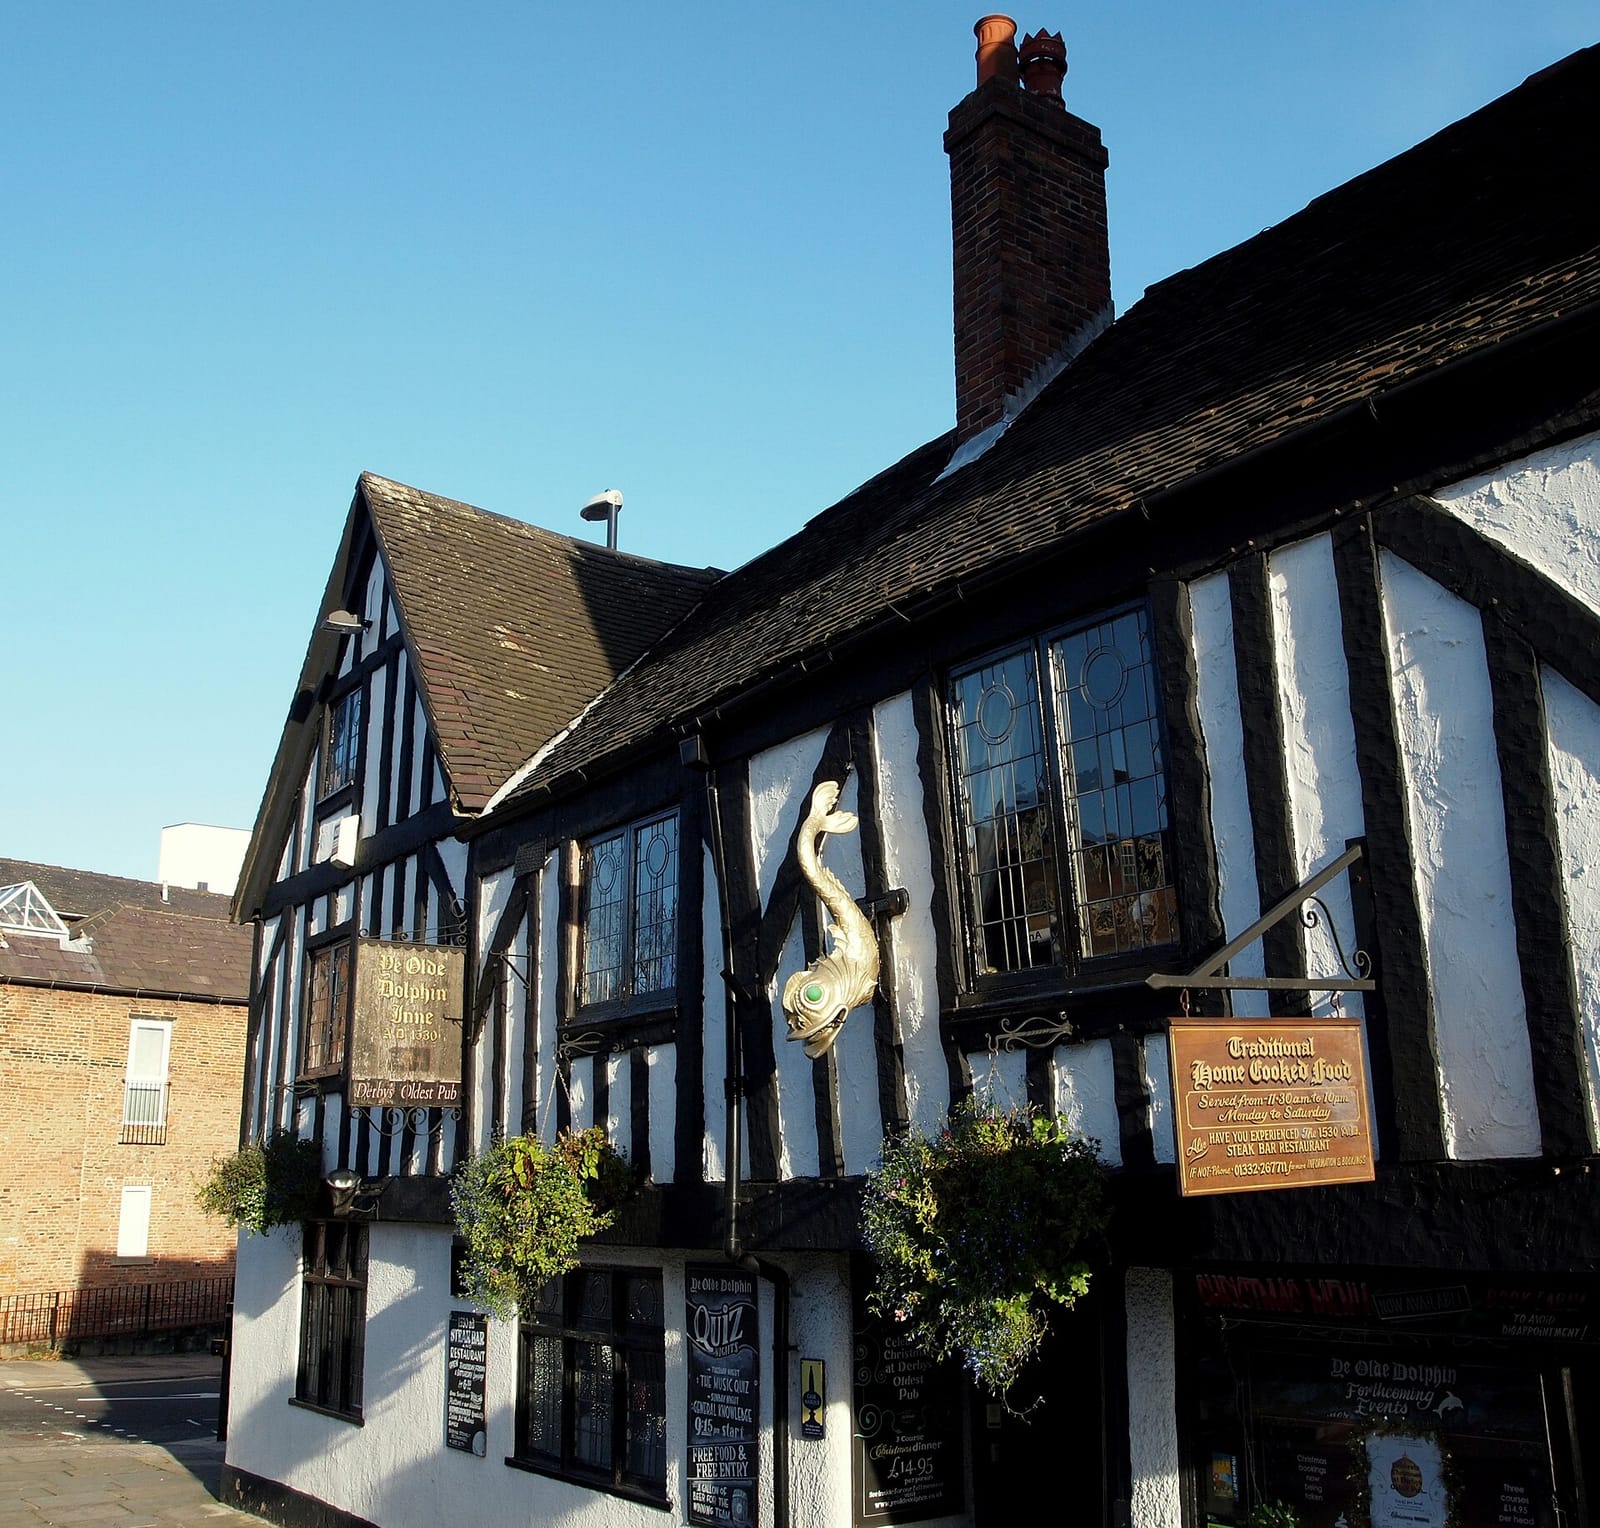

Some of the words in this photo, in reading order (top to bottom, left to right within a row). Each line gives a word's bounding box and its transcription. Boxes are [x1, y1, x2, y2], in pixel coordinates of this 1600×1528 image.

[406, 956, 446, 976] Olde
[379, 979, 448, 1004] Dolphin
[391, 1004, 434, 1024] Inne
[412, 1029, 438, 1041] 1530
[1227, 1036, 1315, 1058] Traditional
[1191, 1060, 1245, 1090] Home
[1249, 1058, 1309, 1085] Cooked
[1310, 1057, 1352, 1085] Food
[355, 1082, 394, 1099] Derby's
[401, 1082, 434, 1100] Oldest
[438, 1084, 457, 1100] Pub
[1199, 1094, 1237, 1108] Served
[1311, 1092, 1321, 1103] to
[1218, 1108, 1267, 1123] Monday
[1270, 1109, 1281, 1119] to
[1283, 1105, 1330, 1121] Saturday
[1209, 1131, 1230, 1145] HAVE
[1232, 1130, 1248, 1143] YOU
[1250, 1128, 1299, 1142] EXPERIENCED
[1301, 1127, 1316, 1139] The
[1319, 1126, 1338, 1138] 1530
[1227, 1143, 1254, 1156] STEAK
[1258, 1142, 1277, 1155] BAR
[1279, 1139, 1330, 1154] RESTAURANT
[1189, 1167, 1196, 1179] IF
[1306, 1157, 1336, 1170] INFORMATION
[702, 1278, 719, 1291] Olde
[720, 1279, 752, 1294] Dolphin
[1513, 1313, 1526, 1324] TO
[450, 1328, 471, 1343] STEAK
[471, 1330, 485, 1346] BAR
[450, 1346, 485, 1363] RESTAURANT
[885, 1363, 895, 1374] at
[1354, 1359, 1391, 1377] Olde
[1391, 1361, 1457, 1388] Dolphin
[699, 1374, 712, 1388] THE
[713, 1376, 733, 1392] MUSIC
[734, 1379, 749, 1394] QUIZ
[893, 1375, 924, 1387] Oldest
[898, 1388, 919, 1401] Pub
[1345, 1382, 1435, 1410] Forthcoming
[693, 1400, 717, 1417] GENERAL
[718, 1404, 753, 1423] KNOWLEDGE
[1355, 1397, 1408, 1416] Events
[722, 1422, 745, 1439] start
[692, 1447, 714, 1463] FREE
[714, 1446, 736, 1461] FOOD
[738, 1444, 747, 1461] &
[912, 1441, 942, 1452] dinner
[1296, 1454, 1327, 1465] Christmas
[696, 1463, 718, 1478] FREE
[719, 1461, 749, 1477] ENTRY
[1298, 1464, 1327, 1475] bookings
[1304, 1483, 1323, 1494] being
[1304, 1492, 1324, 1502] taken
[1503, 1483, 1525, 1494] Three
[692, 1490, 706, 1502] BEER
[718, 1497, 729, 1508] THE
[1500, 1494, 1530, 1504] courses
[693, 1502, 714, 1516] WINNING
[714, 1506, 731, 1520] TEAM
[1498, 1514, 1512, 1522] per
[1513, 1515, 1535, 1526] head
